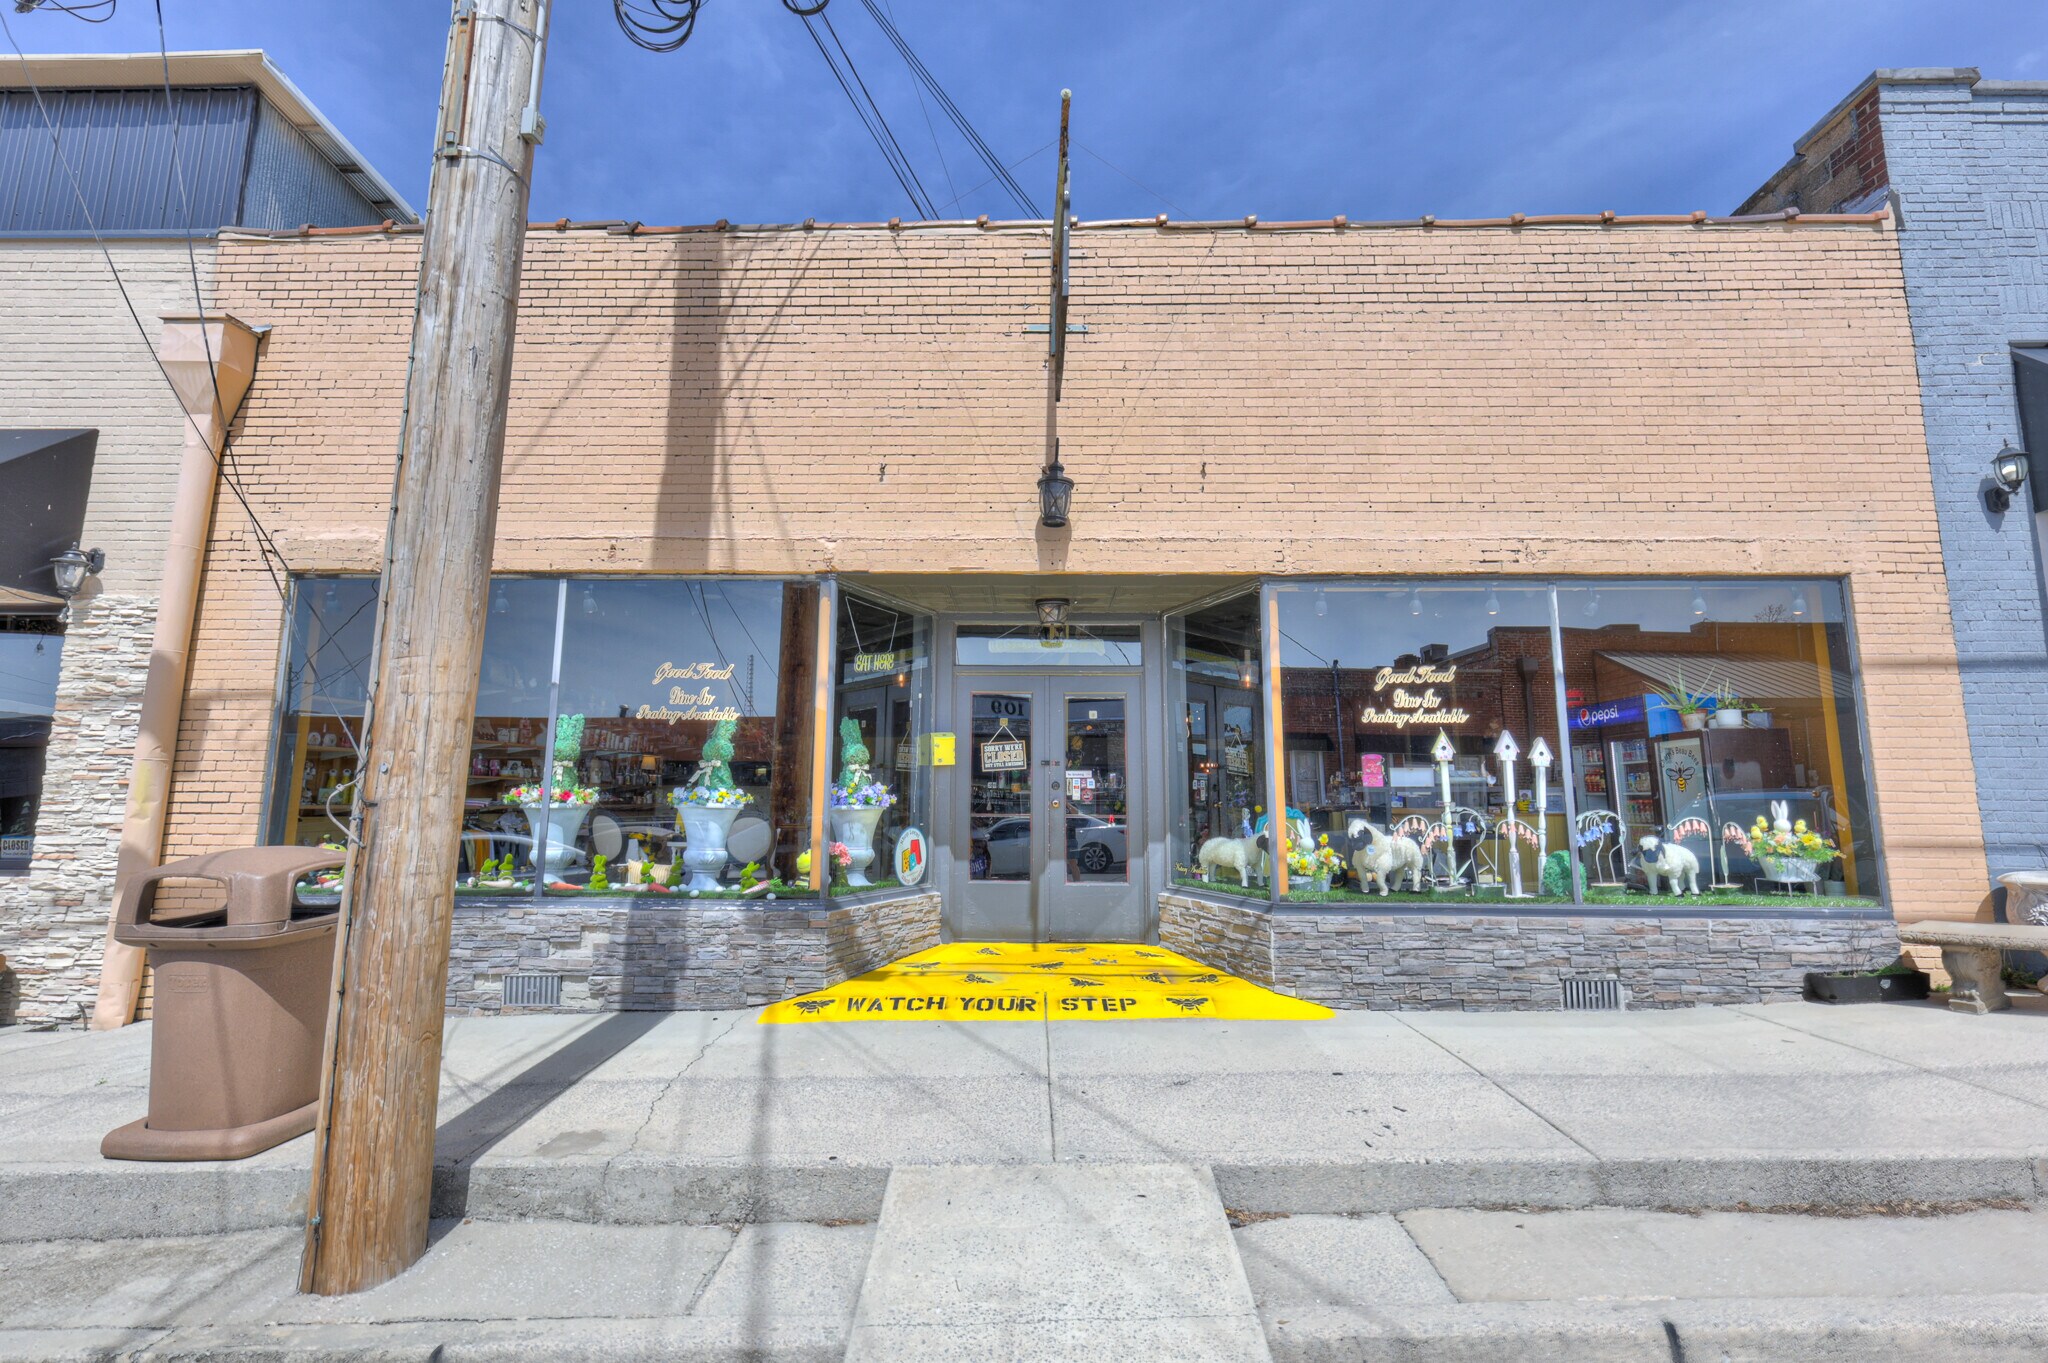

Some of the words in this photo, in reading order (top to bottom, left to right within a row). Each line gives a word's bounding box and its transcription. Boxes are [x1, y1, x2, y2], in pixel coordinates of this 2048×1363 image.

[854, 653, 873, 672] EAT
[873, 653, 895, 671] HERE
[652, 661, 697, 685] Good
[692, 662, 735, 680] Food
[1373, 666, 1417, 692] Good
[1414, 665, 1457, 684] Food
[669, 685, 698, 705] Dine
[697, 686, 716, 706] In
[1393, 688, 1423, 708] Dine
[1421, 688, 1442, 708] In
[635, 704, 682, 725] Seating
[681, 705, 741, 721] Available
[1361, 707, 1411, 729] Seating
[1408, 707, 1470, 724] Available
[1591, 705, 1620, 725] pepsi
[984, 750, 1024, 763] CLOSED
[3, 840, 29, 851] CLOSED
[846, 996, 947, 1012] WATCH
[959, 996, 1038, 1012] YOUR
[1060, 996, 1137, 1012] STEP
